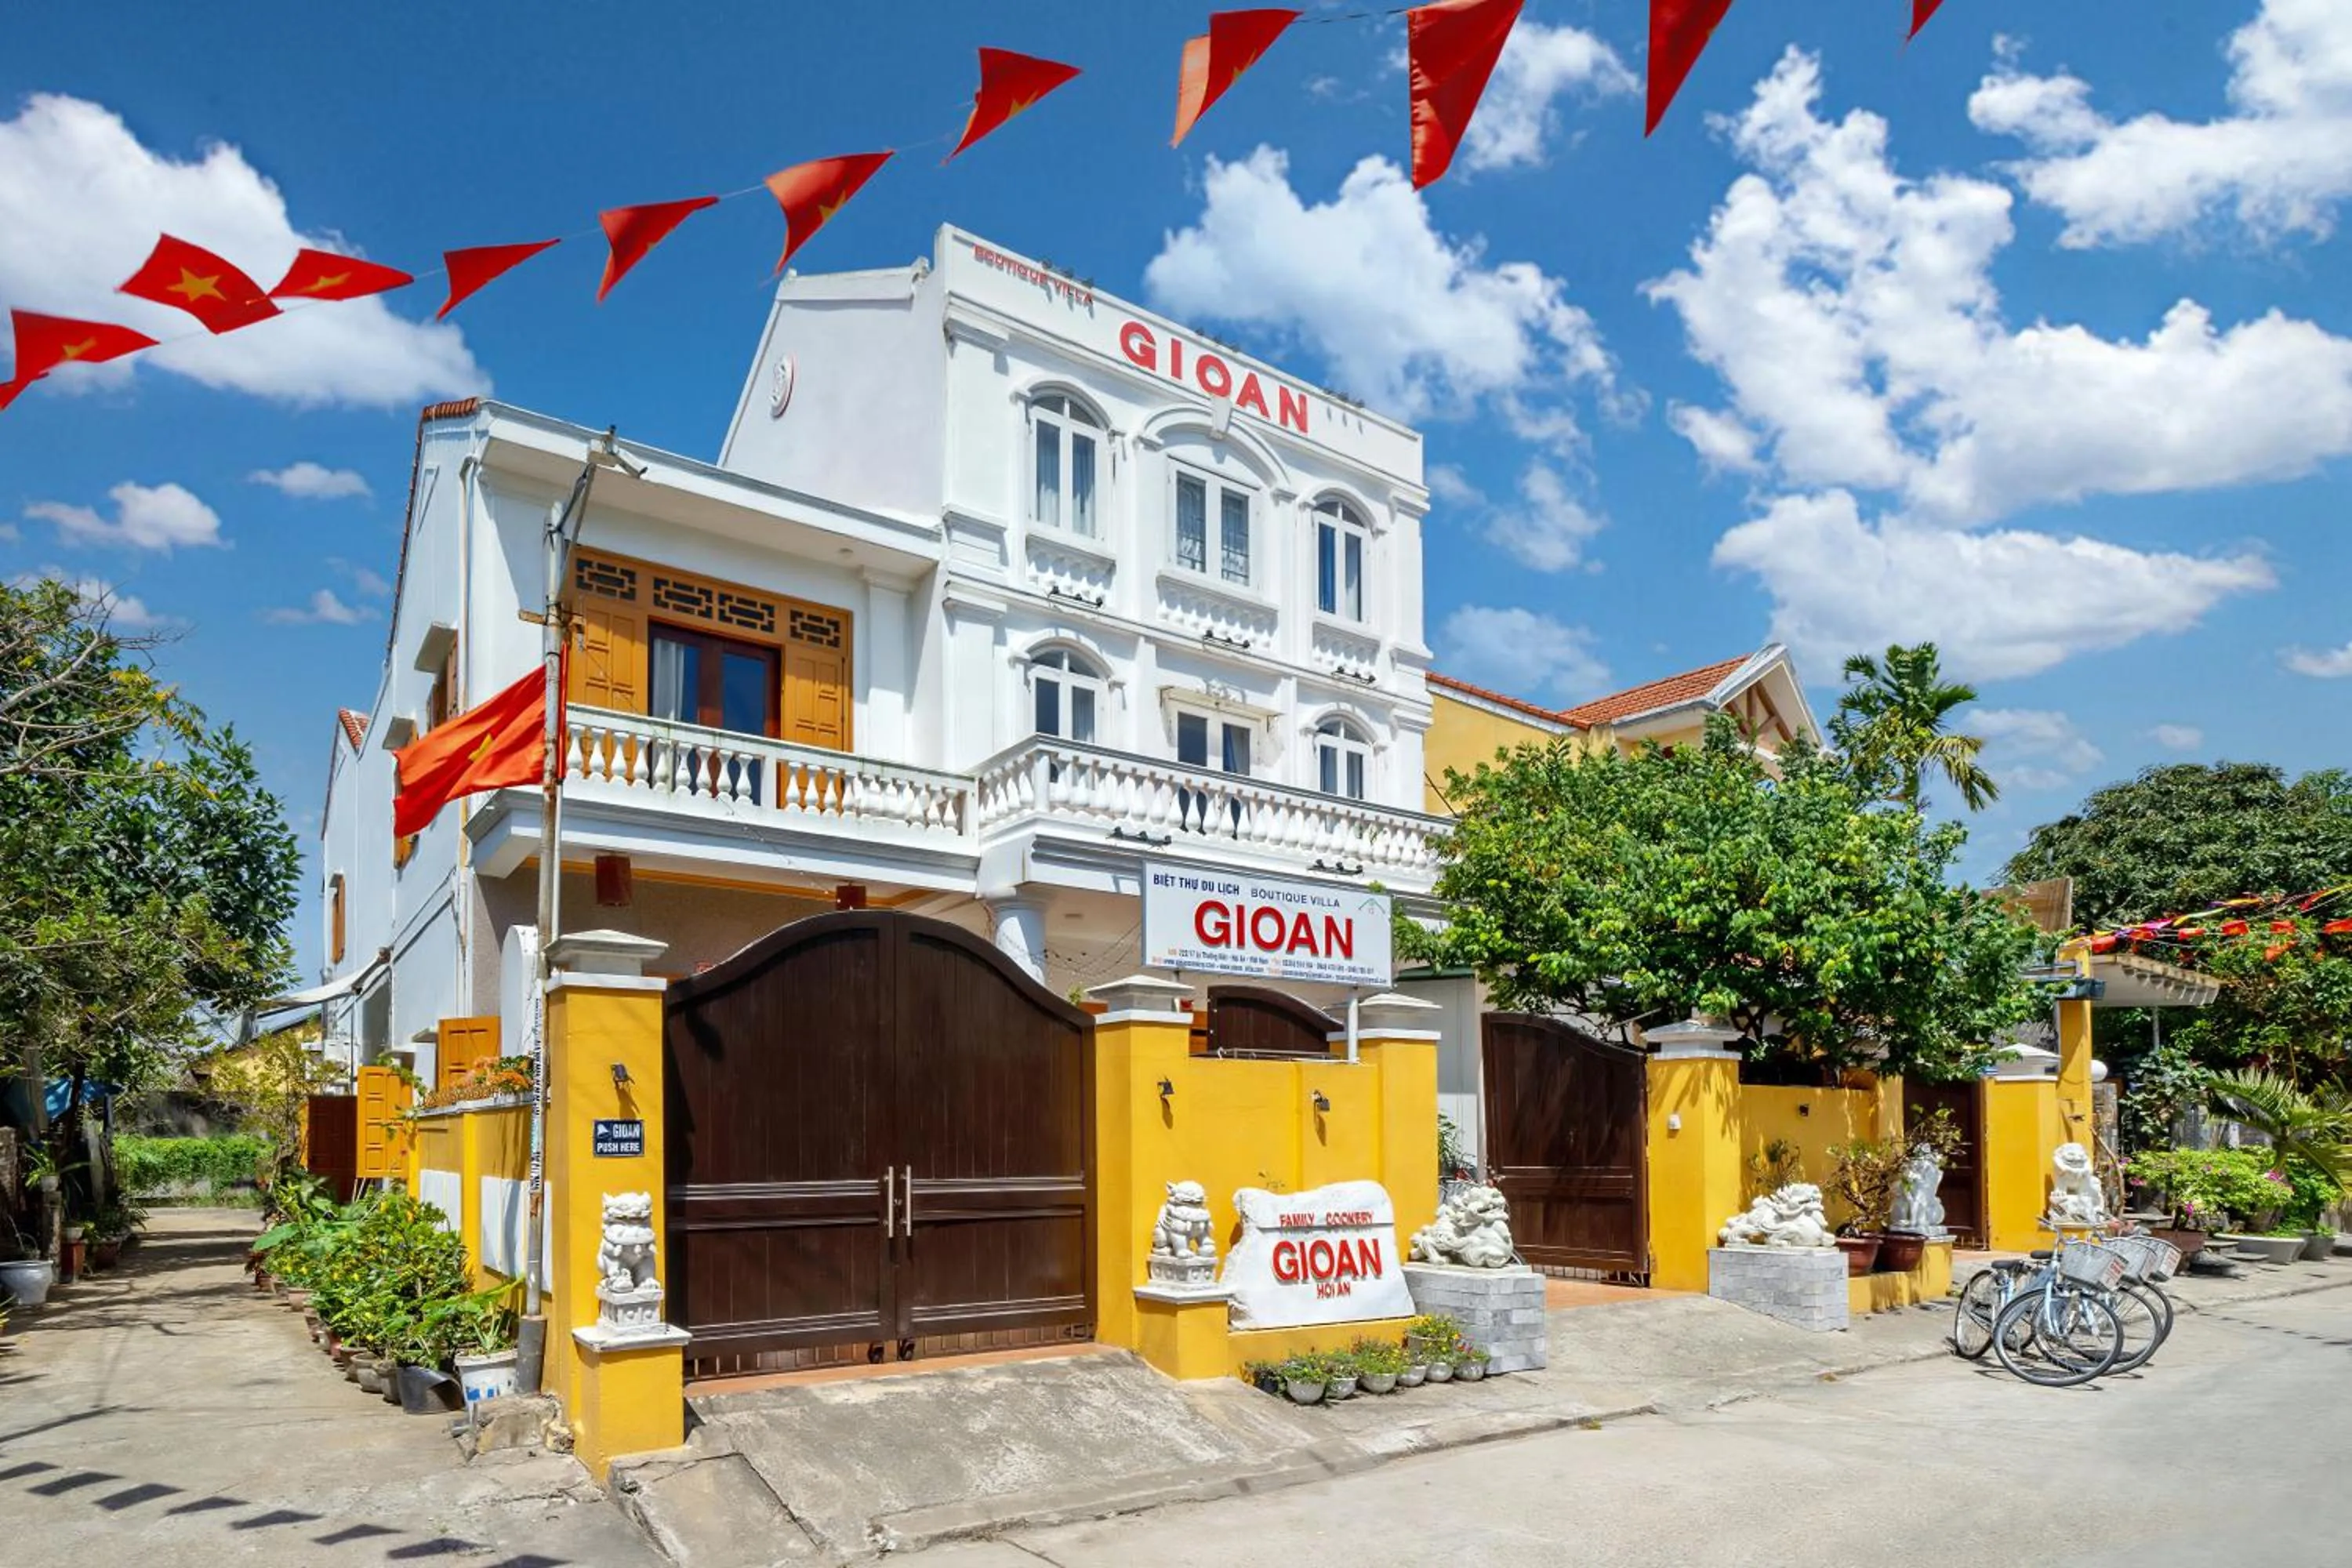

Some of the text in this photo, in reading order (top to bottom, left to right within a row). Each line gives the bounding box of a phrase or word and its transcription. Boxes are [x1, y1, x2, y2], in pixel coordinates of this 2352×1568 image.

[975, 245, 1094, 306] BOUTIQUE VILLA
[1120, 321, 1309, 434] GIOAN
[1201, 880, 1214, 891] DU
[1250, 887, 1307, 904] BOUTIQUE
[1310, 895, 1340, 907] VILLA
[1194, 899, 1353, 959] GIOAN
[612, 1123, 641, 1138] GIOAN
[597, 1142, 641, 1153] PUSH HERE
[1279, 1212, 1374, 1228] FAMILY COOKERY
[1272, 1239, 1383, 1282] GIOAN
[1337, 1282, 1351, 1296] AN
